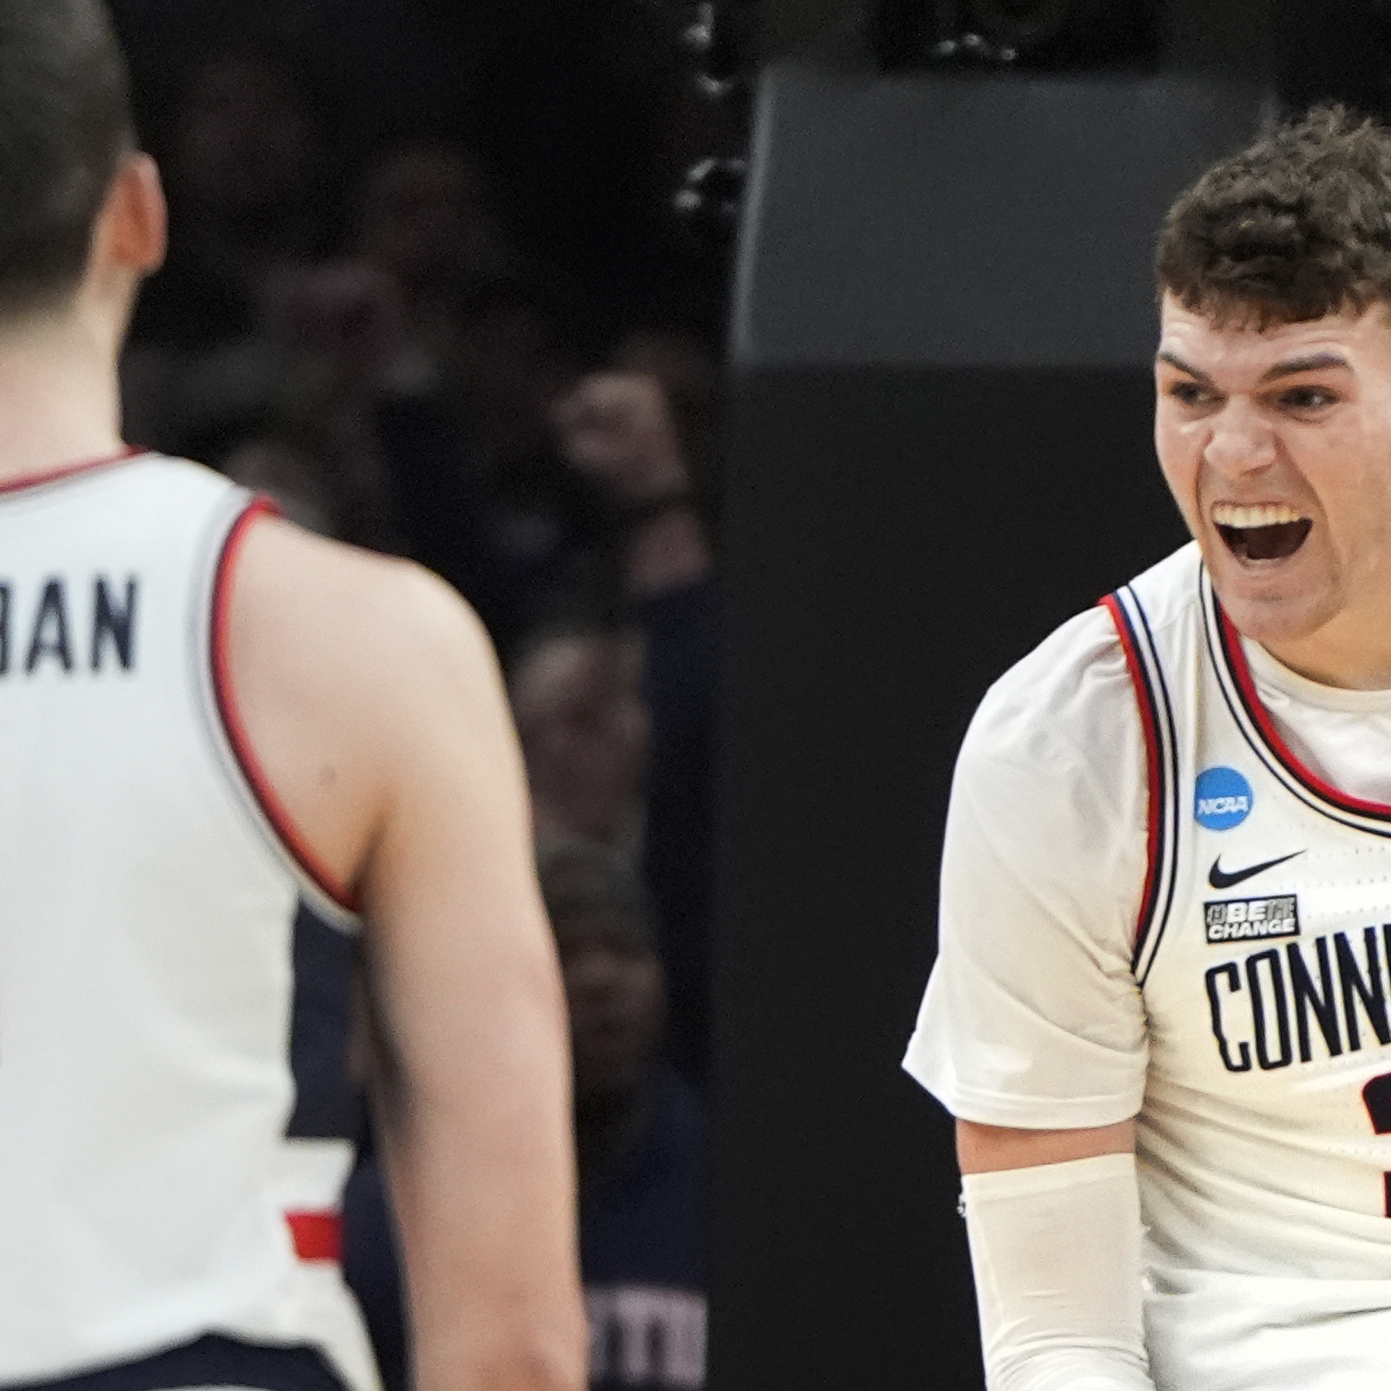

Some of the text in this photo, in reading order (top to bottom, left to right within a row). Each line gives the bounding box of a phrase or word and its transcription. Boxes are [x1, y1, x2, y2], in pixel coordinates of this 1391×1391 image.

[1198, 795, 1248, 815] NCAA
[1226, 901, 1267, 922] BE
[1207, 918, 1296, 939] CHANGE
